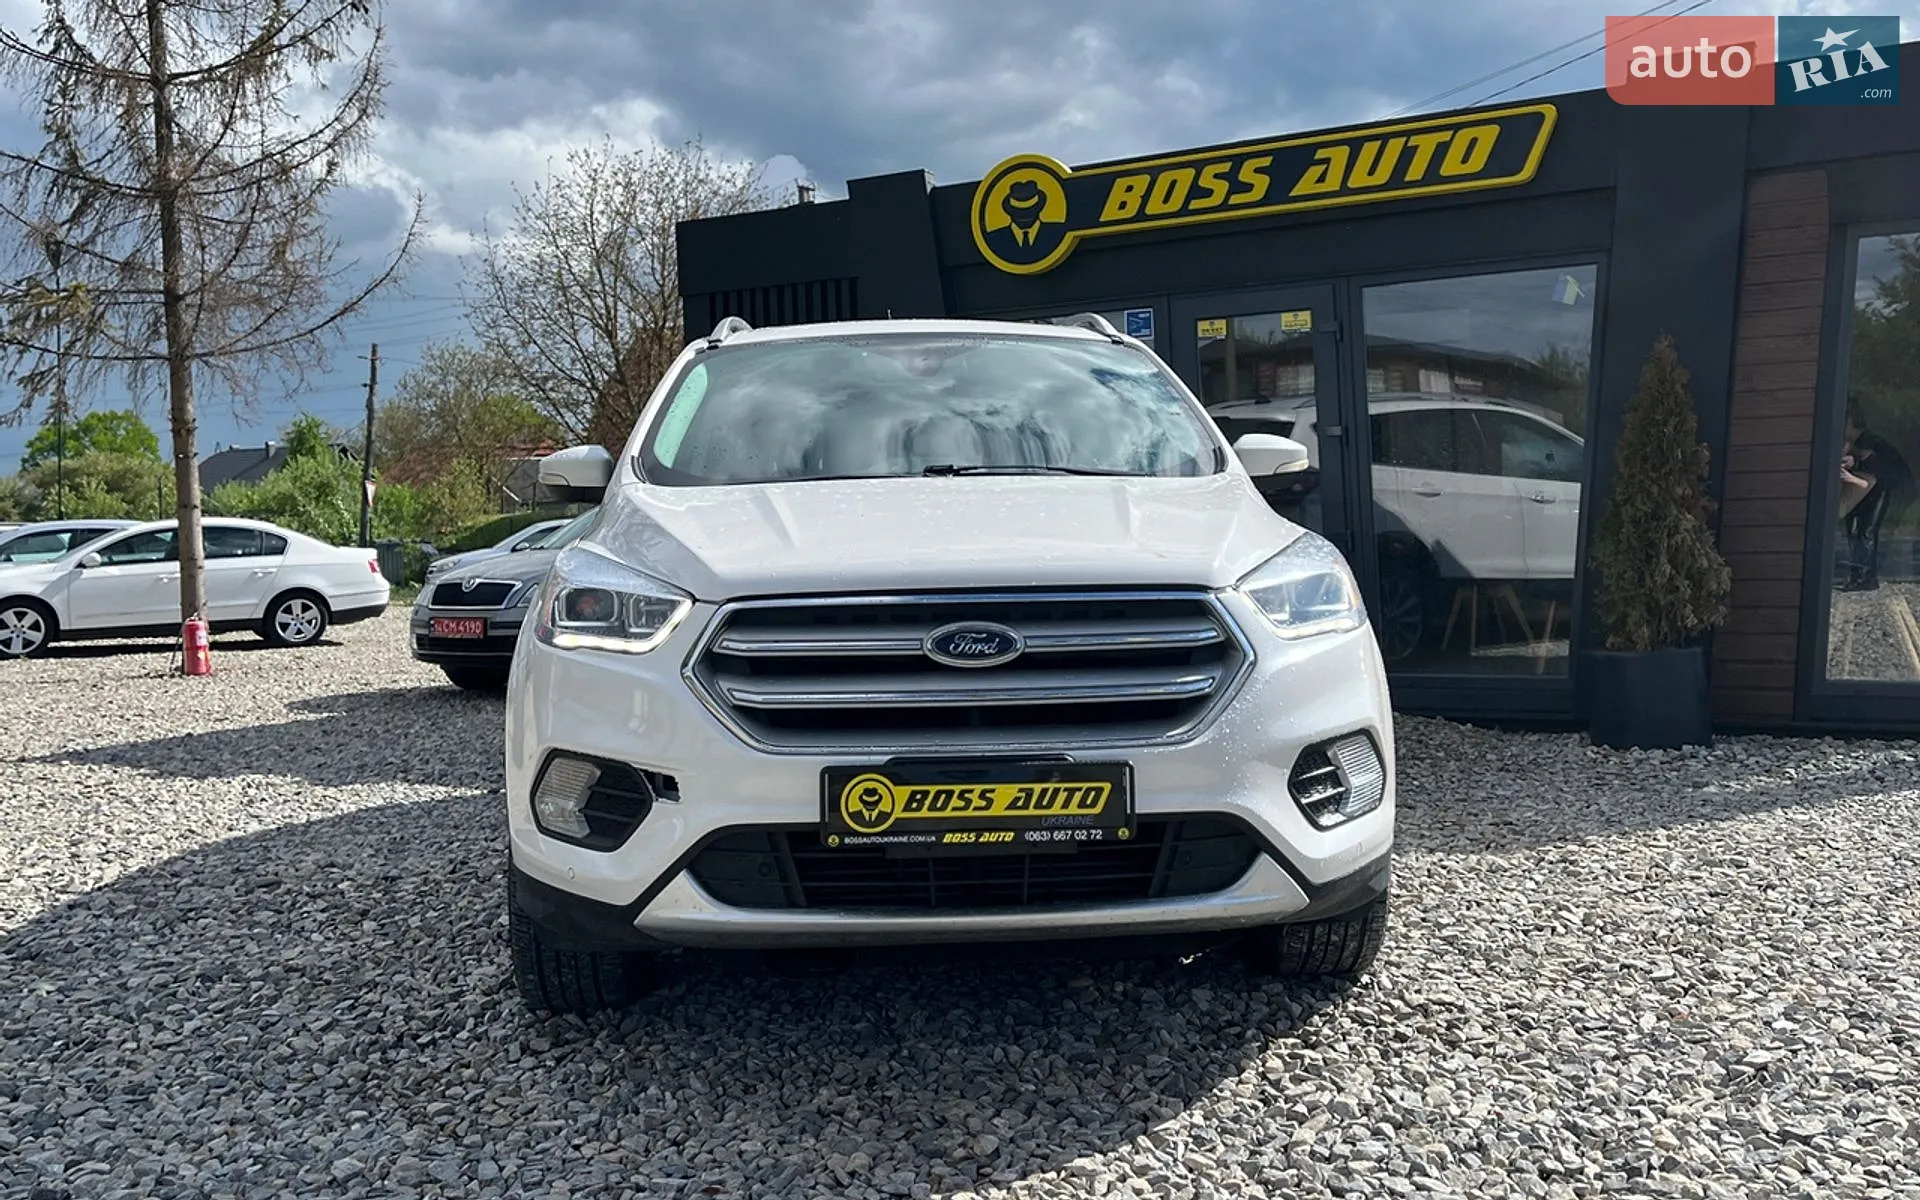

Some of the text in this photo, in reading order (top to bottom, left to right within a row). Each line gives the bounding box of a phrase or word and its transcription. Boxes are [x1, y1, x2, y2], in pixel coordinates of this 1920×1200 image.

[1098, 124, 1502, 222] BOSS AUTO
[949, 632, 1000, 655] Ford
[901, 785, 1106, 813] BOSS AUTO
[1040, 815, 1095, 827] UKRAINE
[942, 832, 976, 844] BOSS
[978, 830, 1015, 843] AUTO
[1024, 830, 1051, 842] (063)
[1053, 829, 1073, 841] 667
[1074, 829, 1088, 841] 02
[1089, 828, 1103, 840] 72
